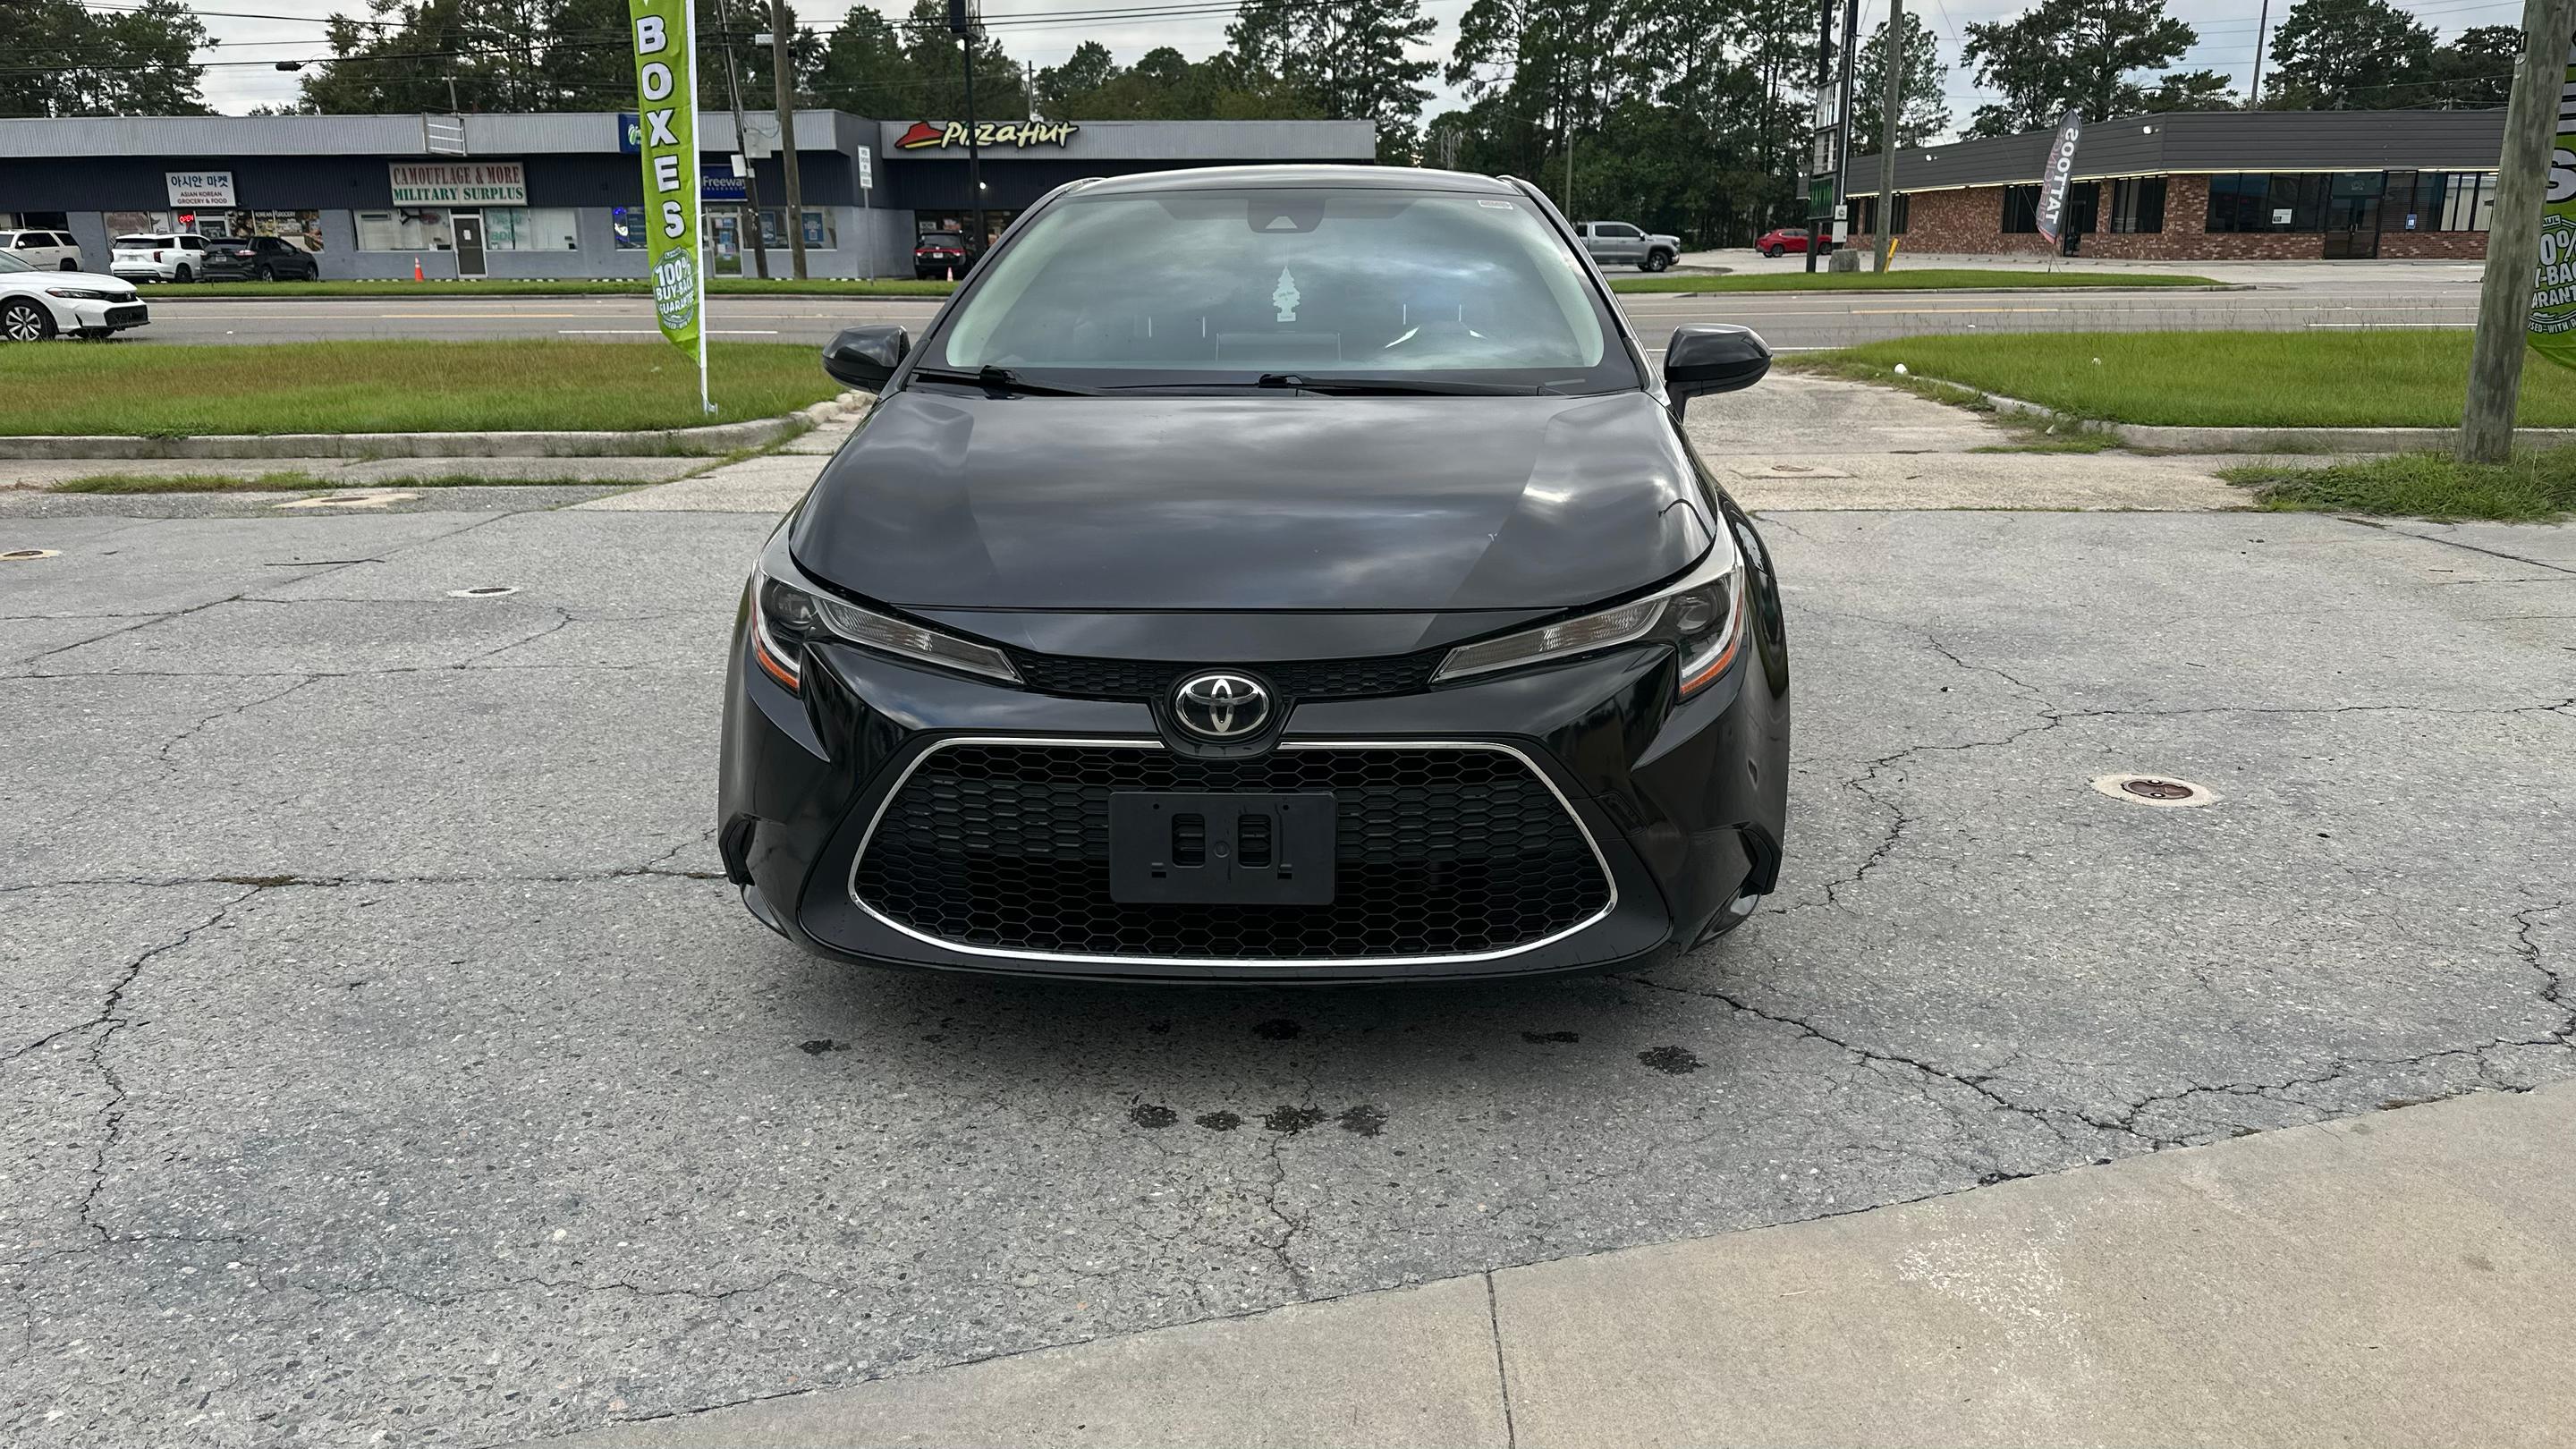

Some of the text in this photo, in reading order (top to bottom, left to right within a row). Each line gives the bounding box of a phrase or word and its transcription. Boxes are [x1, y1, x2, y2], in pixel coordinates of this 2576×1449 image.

[636, 15, 686, 239] BOXES
[171, 175, 228, 188] 아시안 마켓
[394, 165, 521, 185] CAMOUFLAGE & MORE
[394, 187, 523, 201] MILITARY SURPLUS
[179, 215, 194, 224] OPEN
[654, 256, 691, 287] 100%
